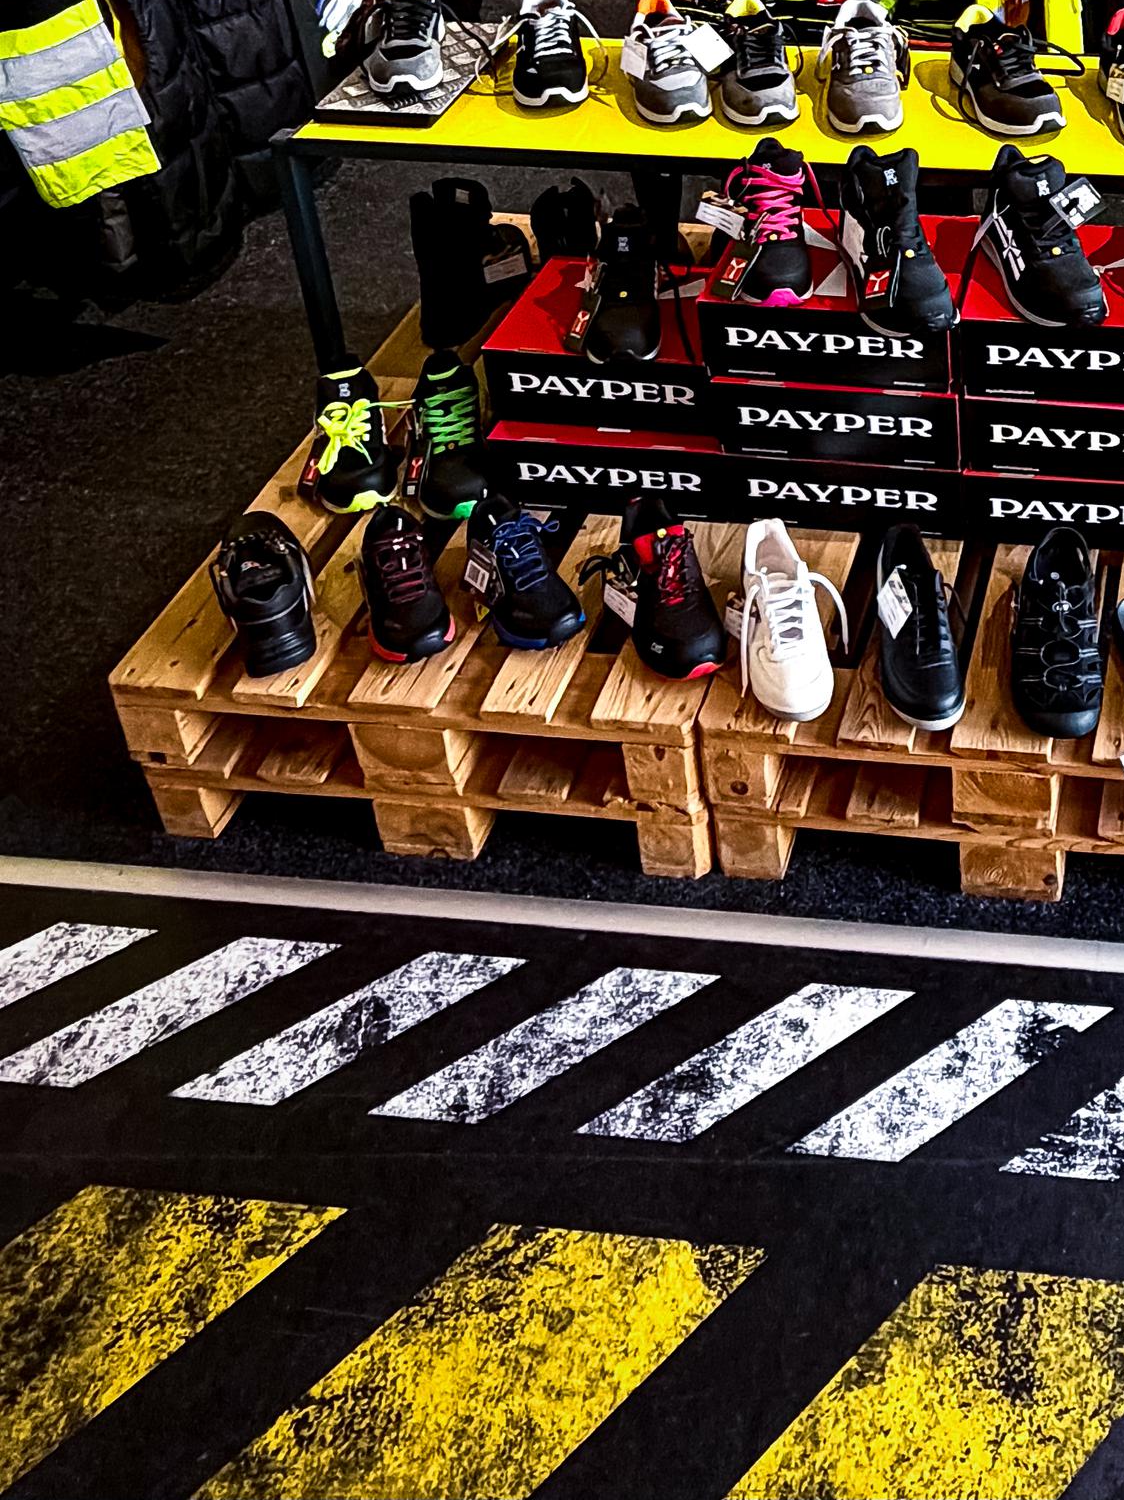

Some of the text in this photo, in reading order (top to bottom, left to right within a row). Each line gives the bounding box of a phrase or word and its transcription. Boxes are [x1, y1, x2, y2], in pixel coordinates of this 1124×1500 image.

[725, 327, 924, 359] PAYPER
[507, 372, 695, 406] PAYPER
[737, 406, 933, 438] PAYPER
[516, 462, 702, 492] PAYPER
[747, 478, 938, 511] PAYPER
